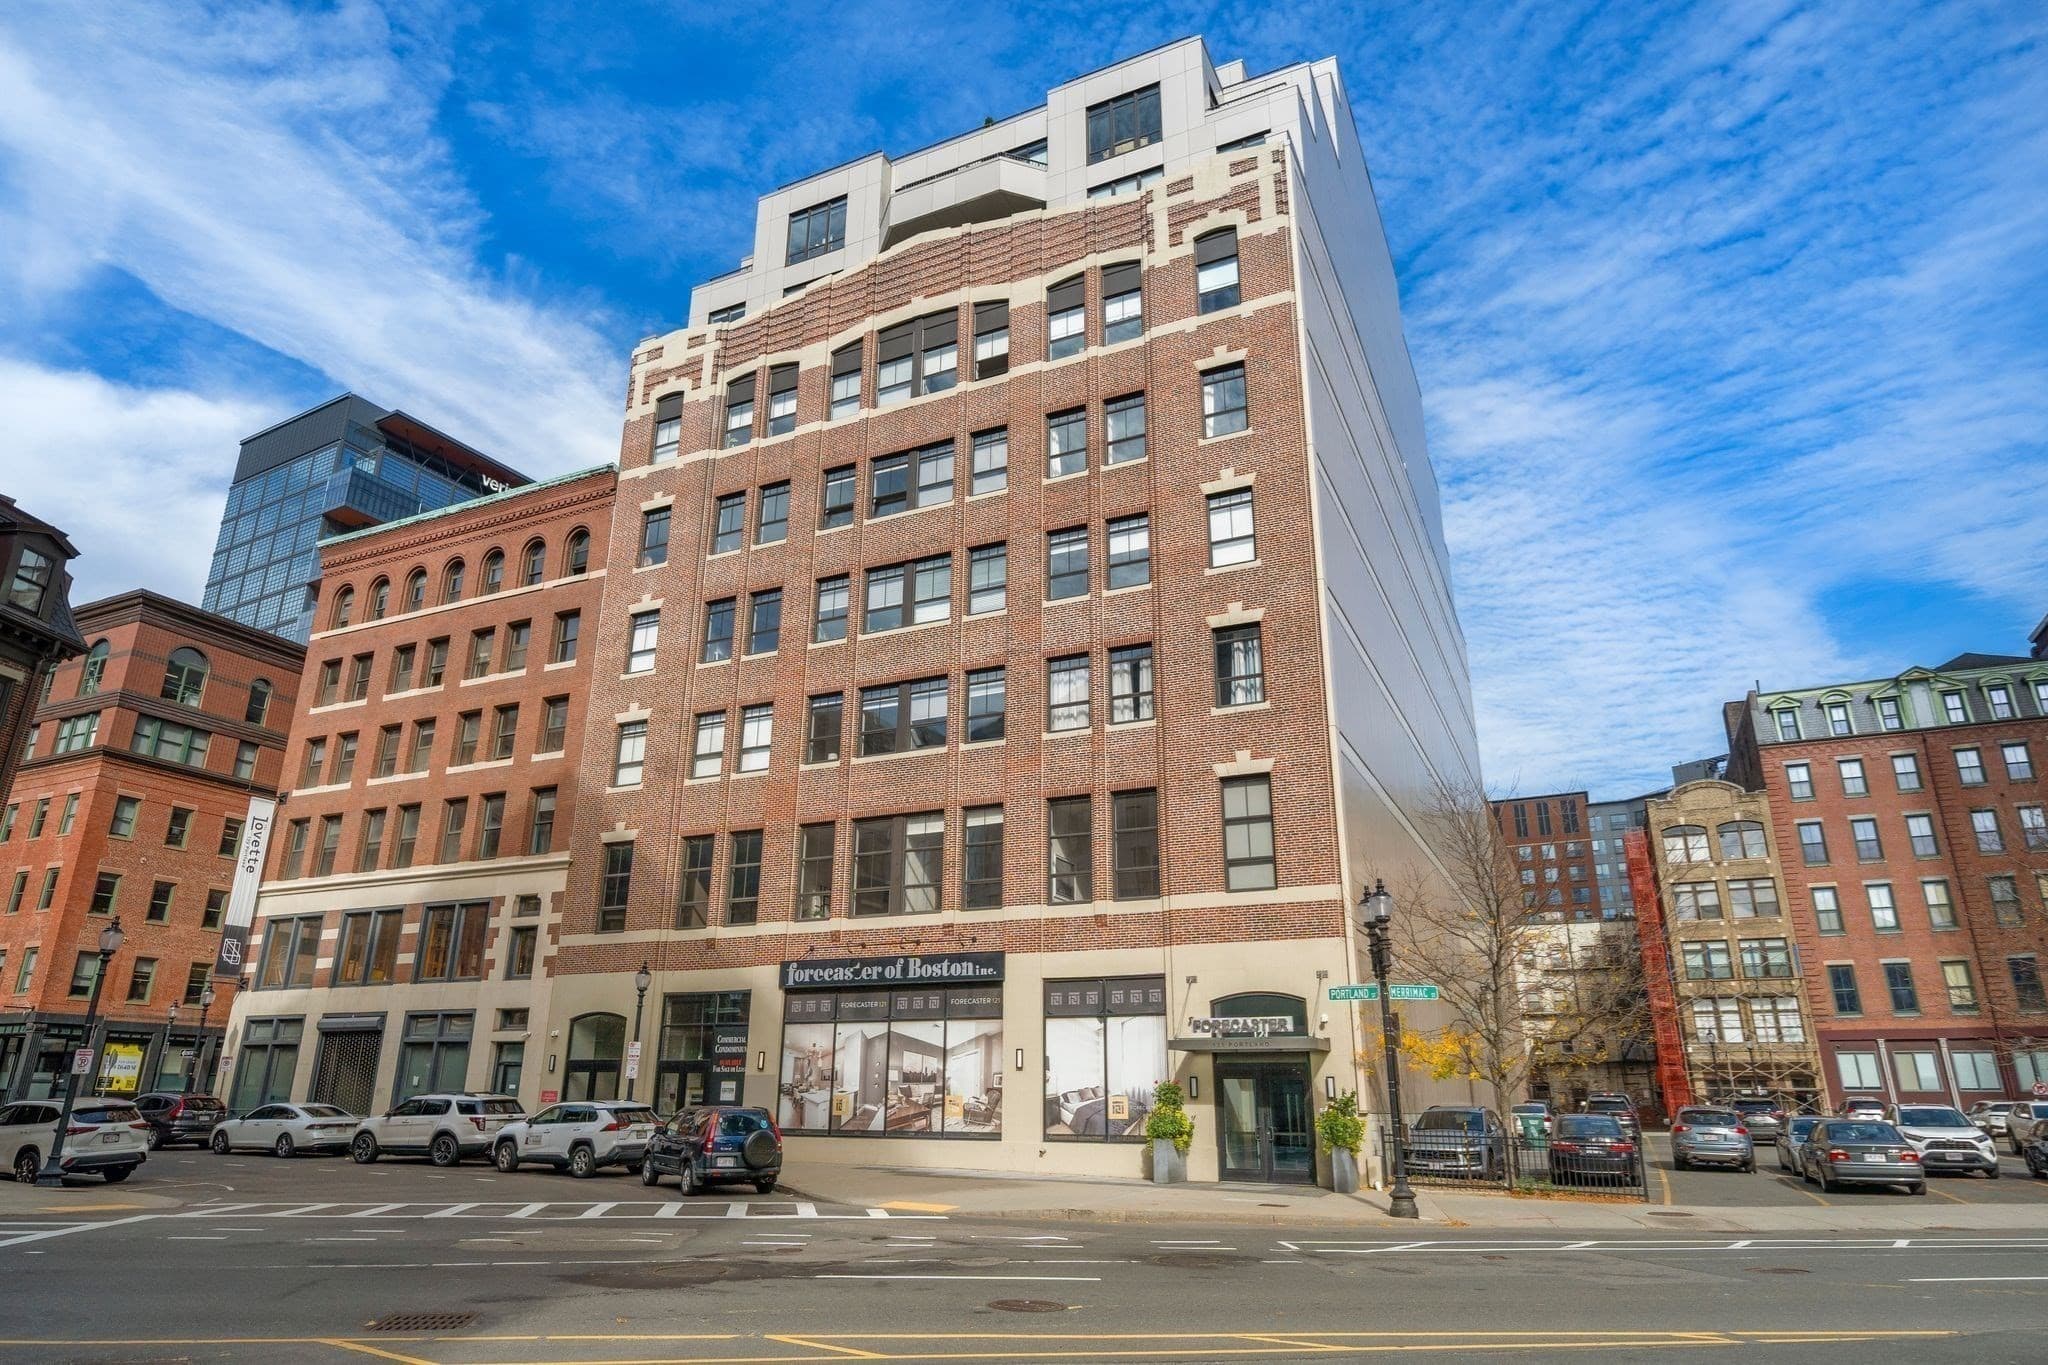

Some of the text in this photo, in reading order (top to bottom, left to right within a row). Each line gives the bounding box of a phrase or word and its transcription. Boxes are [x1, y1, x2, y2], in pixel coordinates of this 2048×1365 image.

[884, 958, 904, 980] of
[907, 957, 974, 979] Boston
[975, 965, 997, 976] inc.
[1330, 988, 1369, 1000] PORTLAND
[1390, 987, 1428, 998] MERRIMAC
[840, 1001, 878, 1009] FORECASTER
[950, 997, 991, 1005] FORECASTER
[1192, 1017, 1289, 1034] FORECASTER
